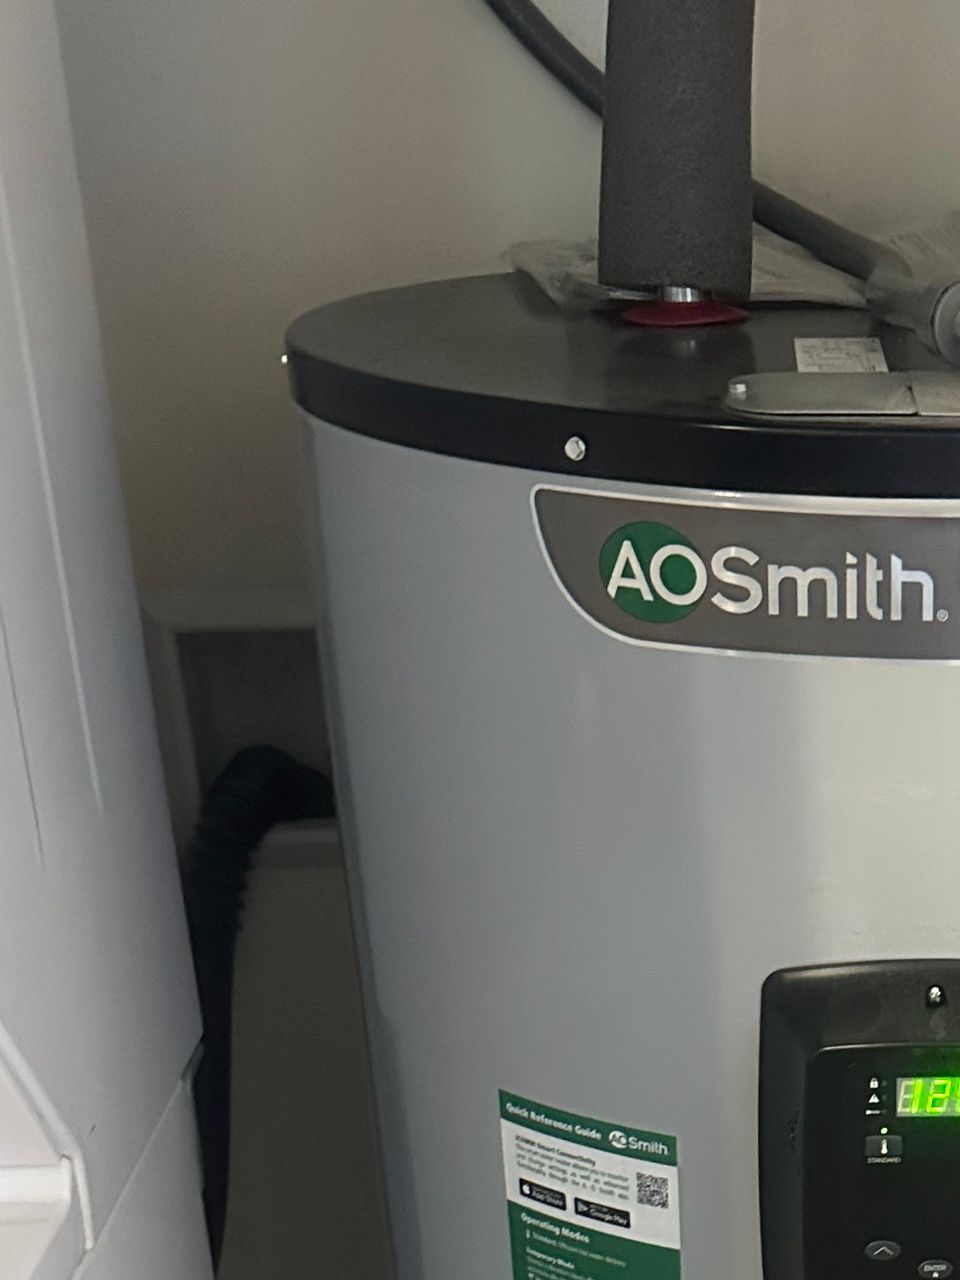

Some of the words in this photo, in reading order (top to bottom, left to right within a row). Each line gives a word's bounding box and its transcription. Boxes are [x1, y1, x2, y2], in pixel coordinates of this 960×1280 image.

[505, 1102, 529, 1119] Quick
[530, 1110, 573, 1133] Reference
[574, 1125, 602, 1141] Guide
[867, 1156, 902, 1164] STANDARD
[521, 1212, 560, 1236] Operating
[561, 1226, 589, 1243] Modes
[924, 1264, 947, 1273] ENTER
